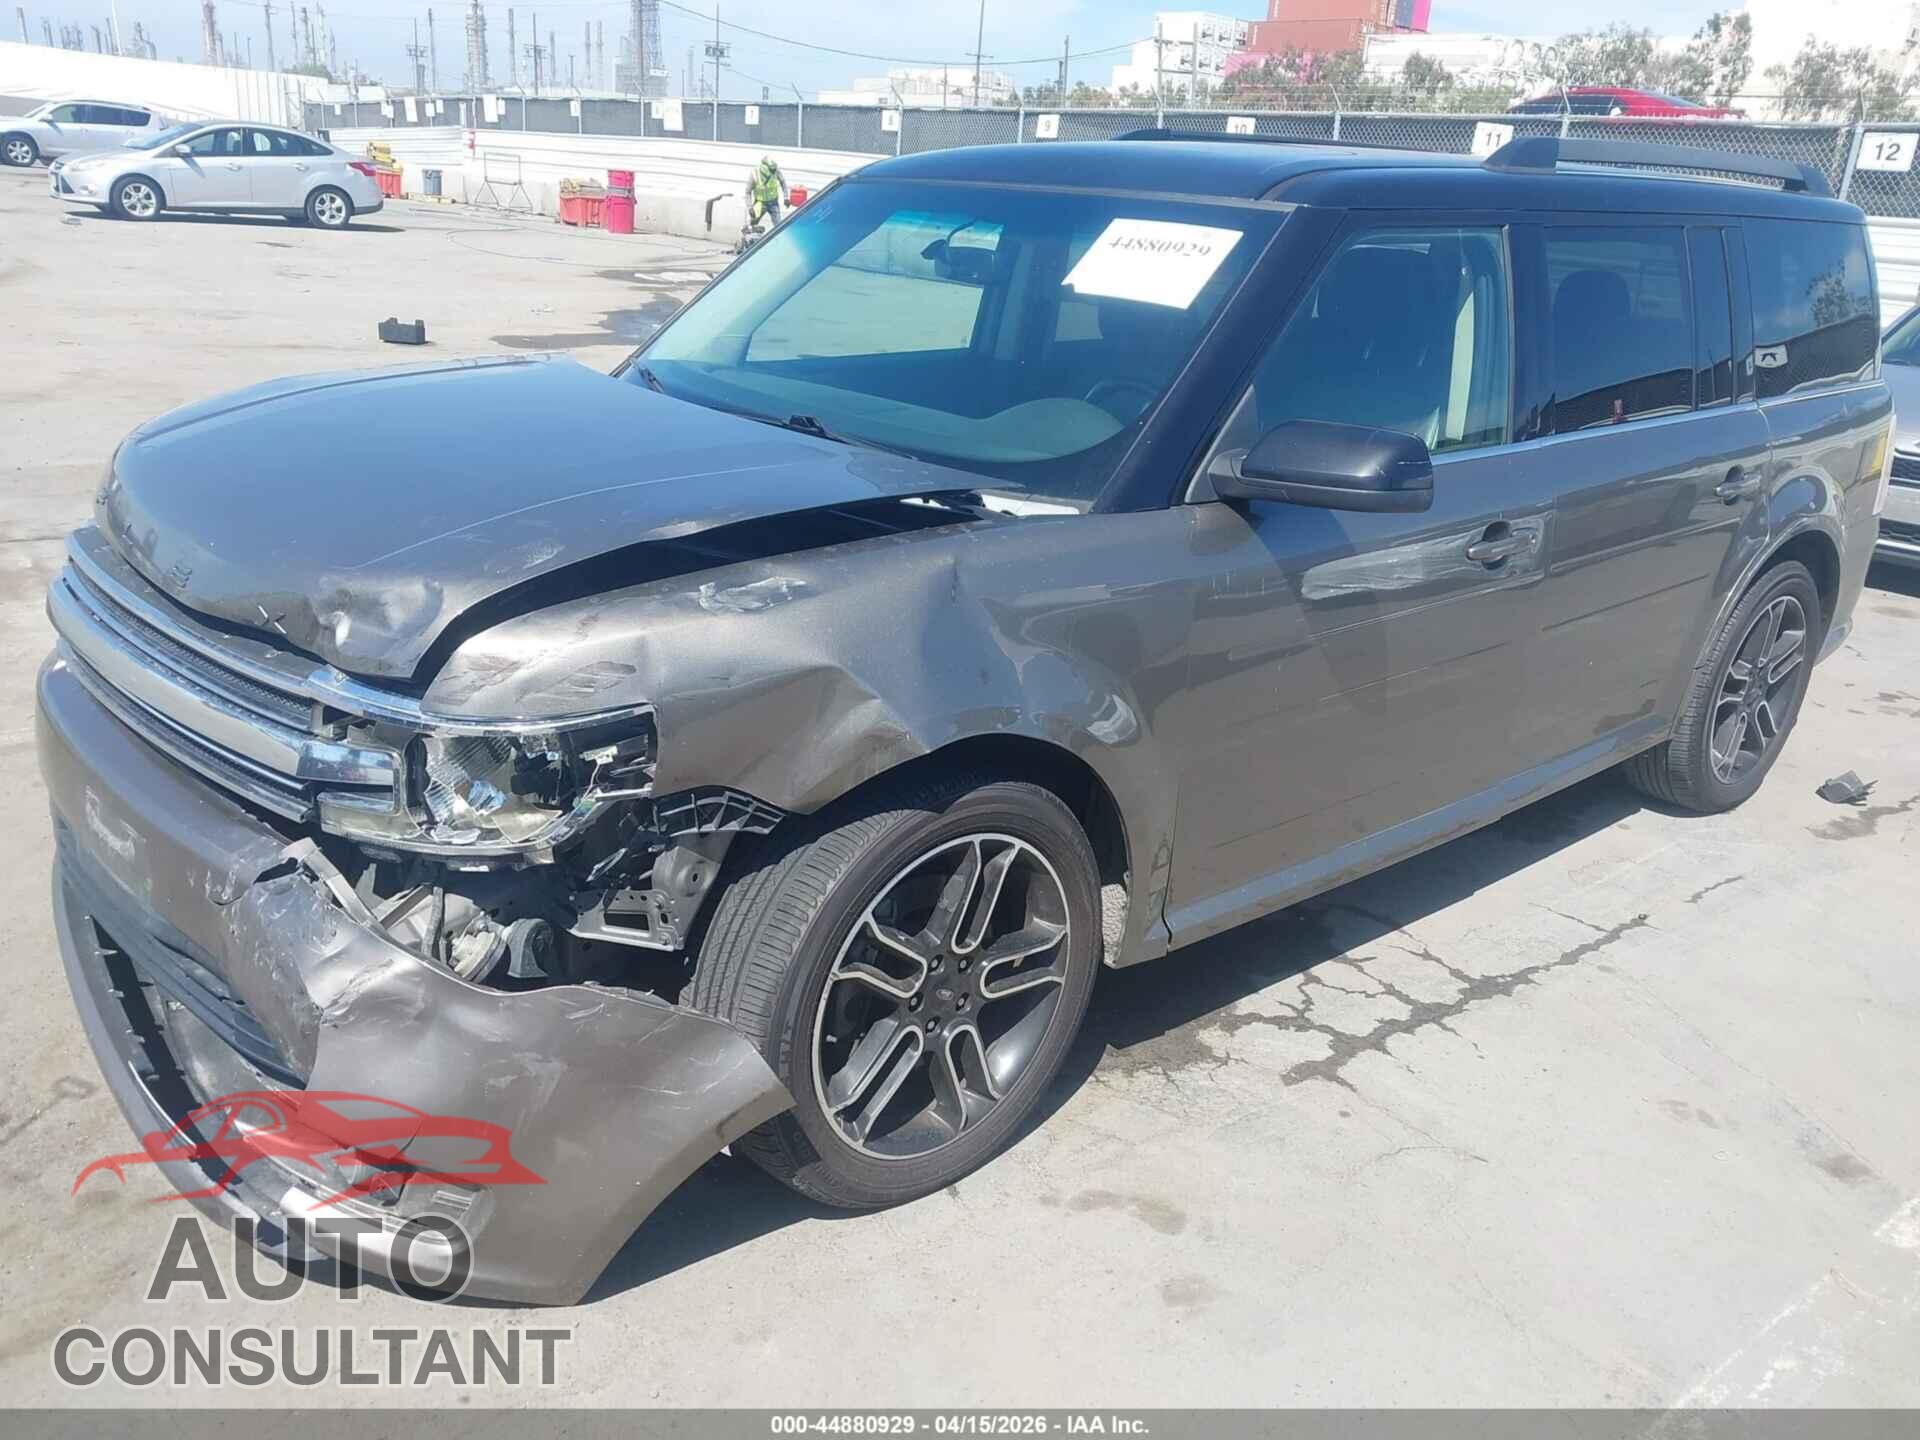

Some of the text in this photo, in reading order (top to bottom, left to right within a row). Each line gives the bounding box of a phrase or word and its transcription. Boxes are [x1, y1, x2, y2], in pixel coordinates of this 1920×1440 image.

[1044, 120, 1052, 132] 9
[1234, 124, 1248, 135] 10
[1486, 132, 1502, 148] 11
[1875, 142, 1901, 161] 12
[1109, 236, 1212, 257] 44880929
